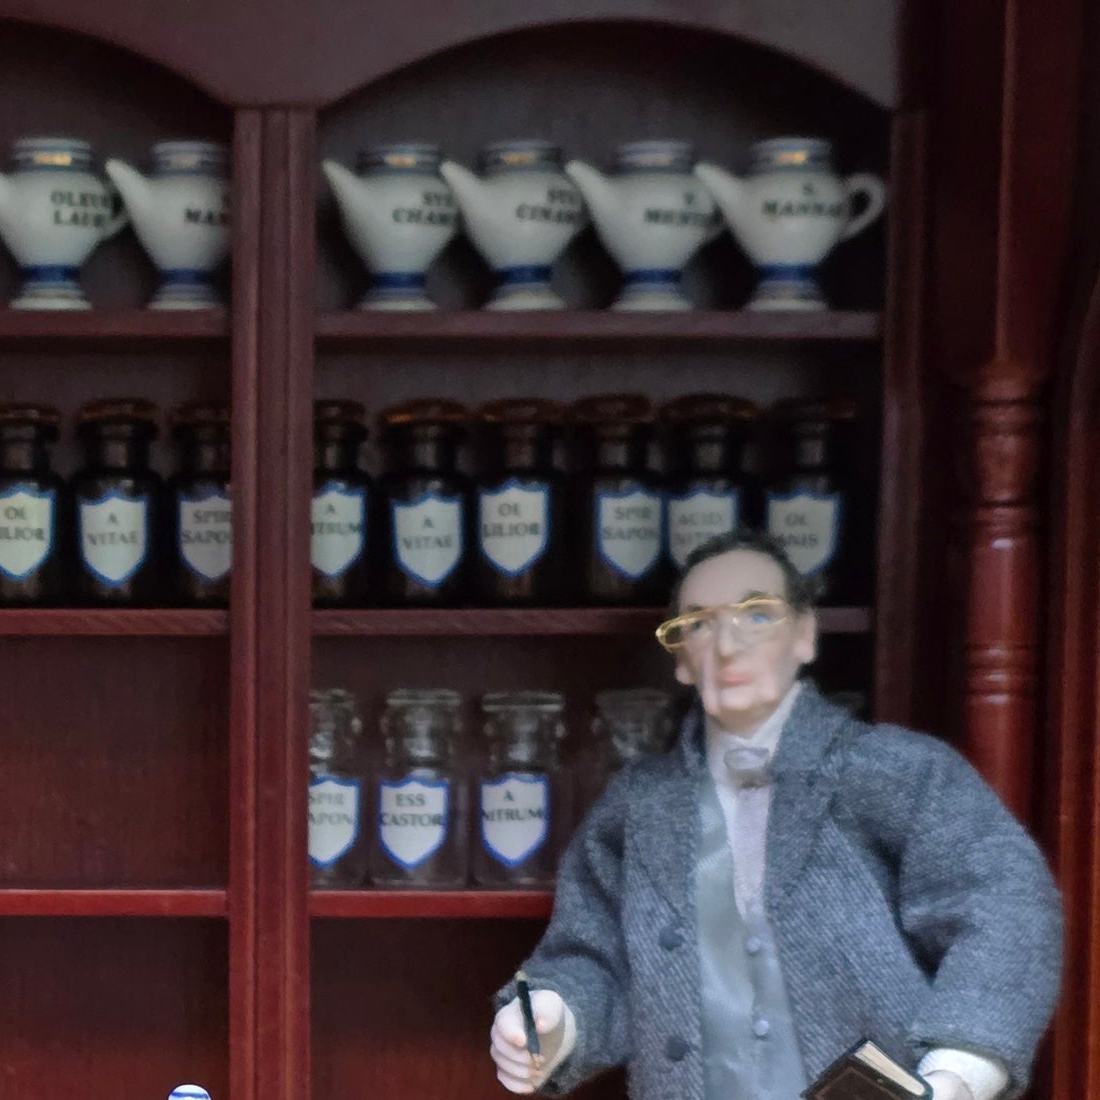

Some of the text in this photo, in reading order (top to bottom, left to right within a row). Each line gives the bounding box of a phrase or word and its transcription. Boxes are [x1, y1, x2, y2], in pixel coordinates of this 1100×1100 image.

[323, 502, 337, 516] A
[497, 502, 522, 517] OL
[421, 514, 434, 529] A
[401, 534, 454, 550] VITAE
[395, 793, 427, 807] ESS
[502, 789, 515, 803] A
